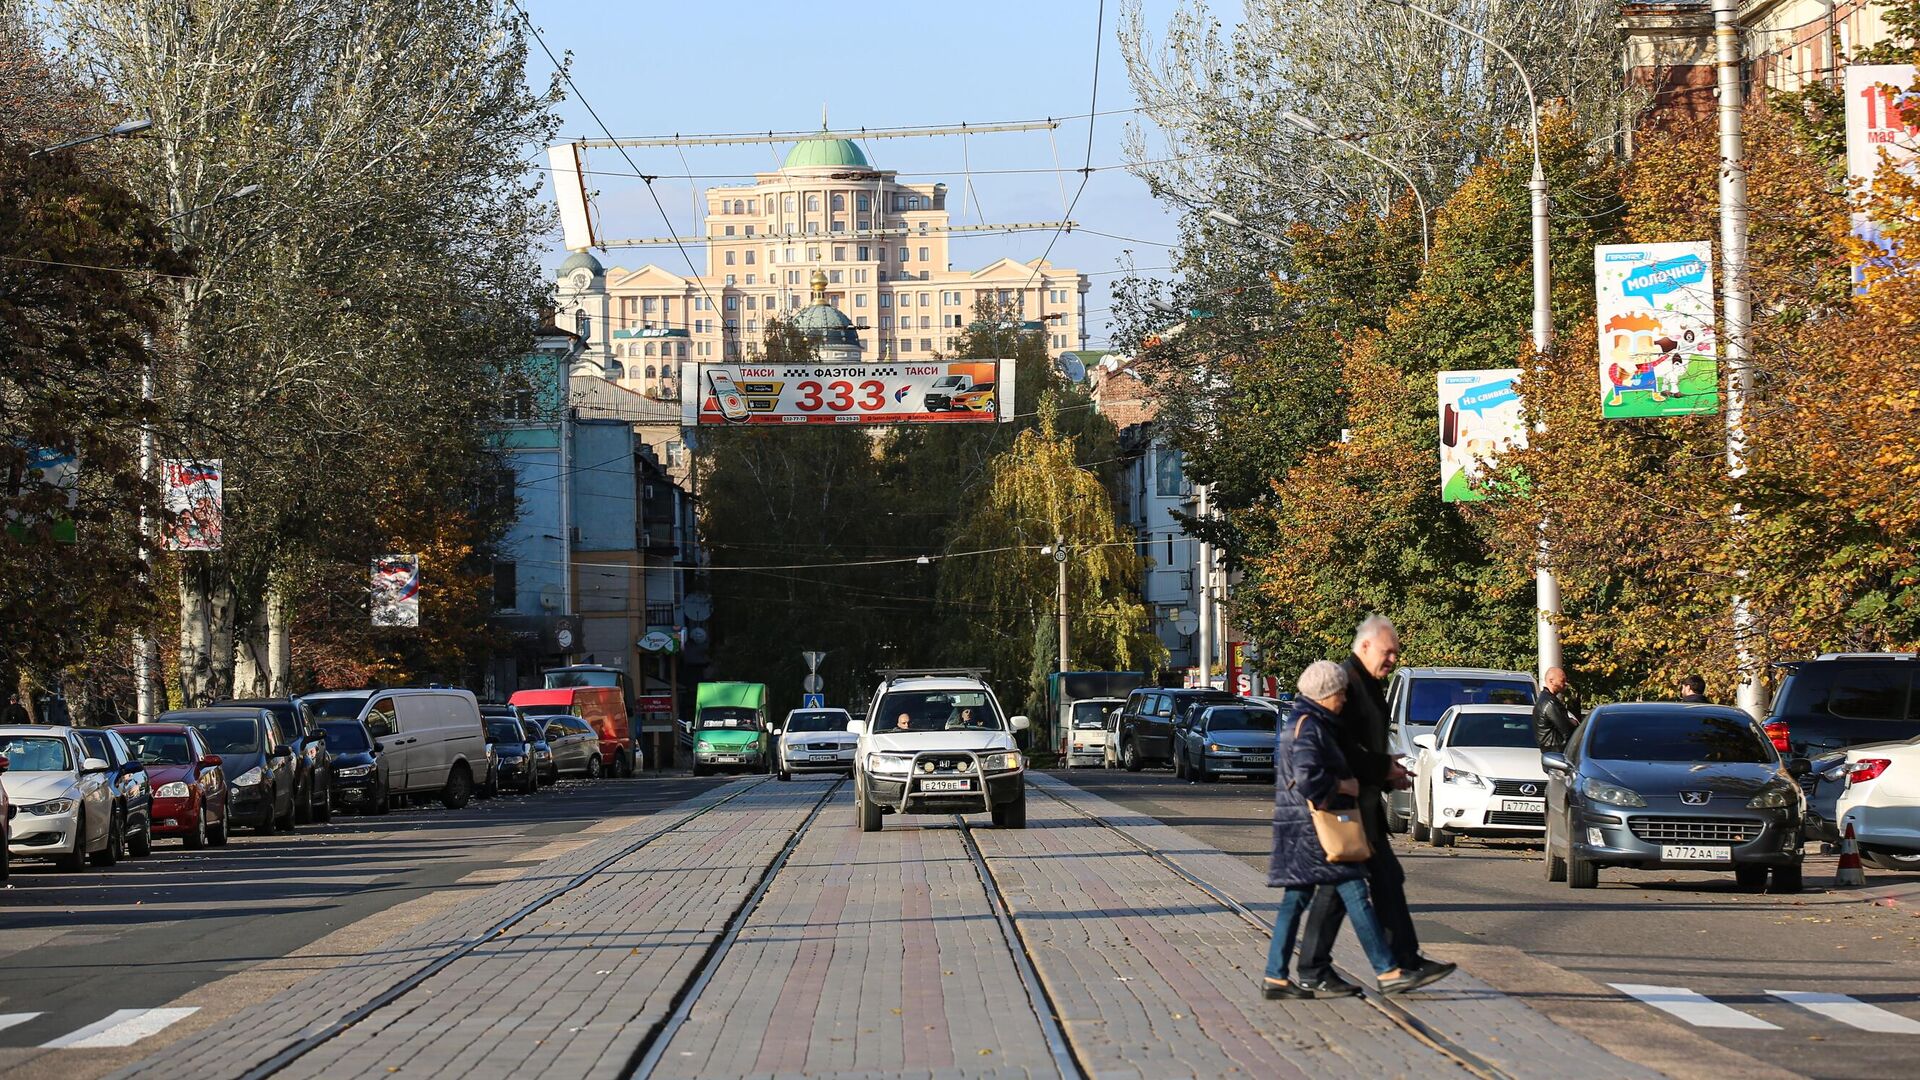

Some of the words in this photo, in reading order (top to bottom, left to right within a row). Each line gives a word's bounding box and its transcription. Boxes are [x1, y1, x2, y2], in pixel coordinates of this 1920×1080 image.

[1868, 131, 1895, 144] мая
[1626, 261, 1701, 291] МОЛОЧНО!
[741, 368, 775, 378] ТАКСИ
[814, 368, 866, 378] ФАЭТОН
[905, 366, 939, 376] ТАКСИ
[795, 380, 886, 411] 333
[1462, 396, 1477, 406] На
[1666, 847, 1713, 858] А772АА
